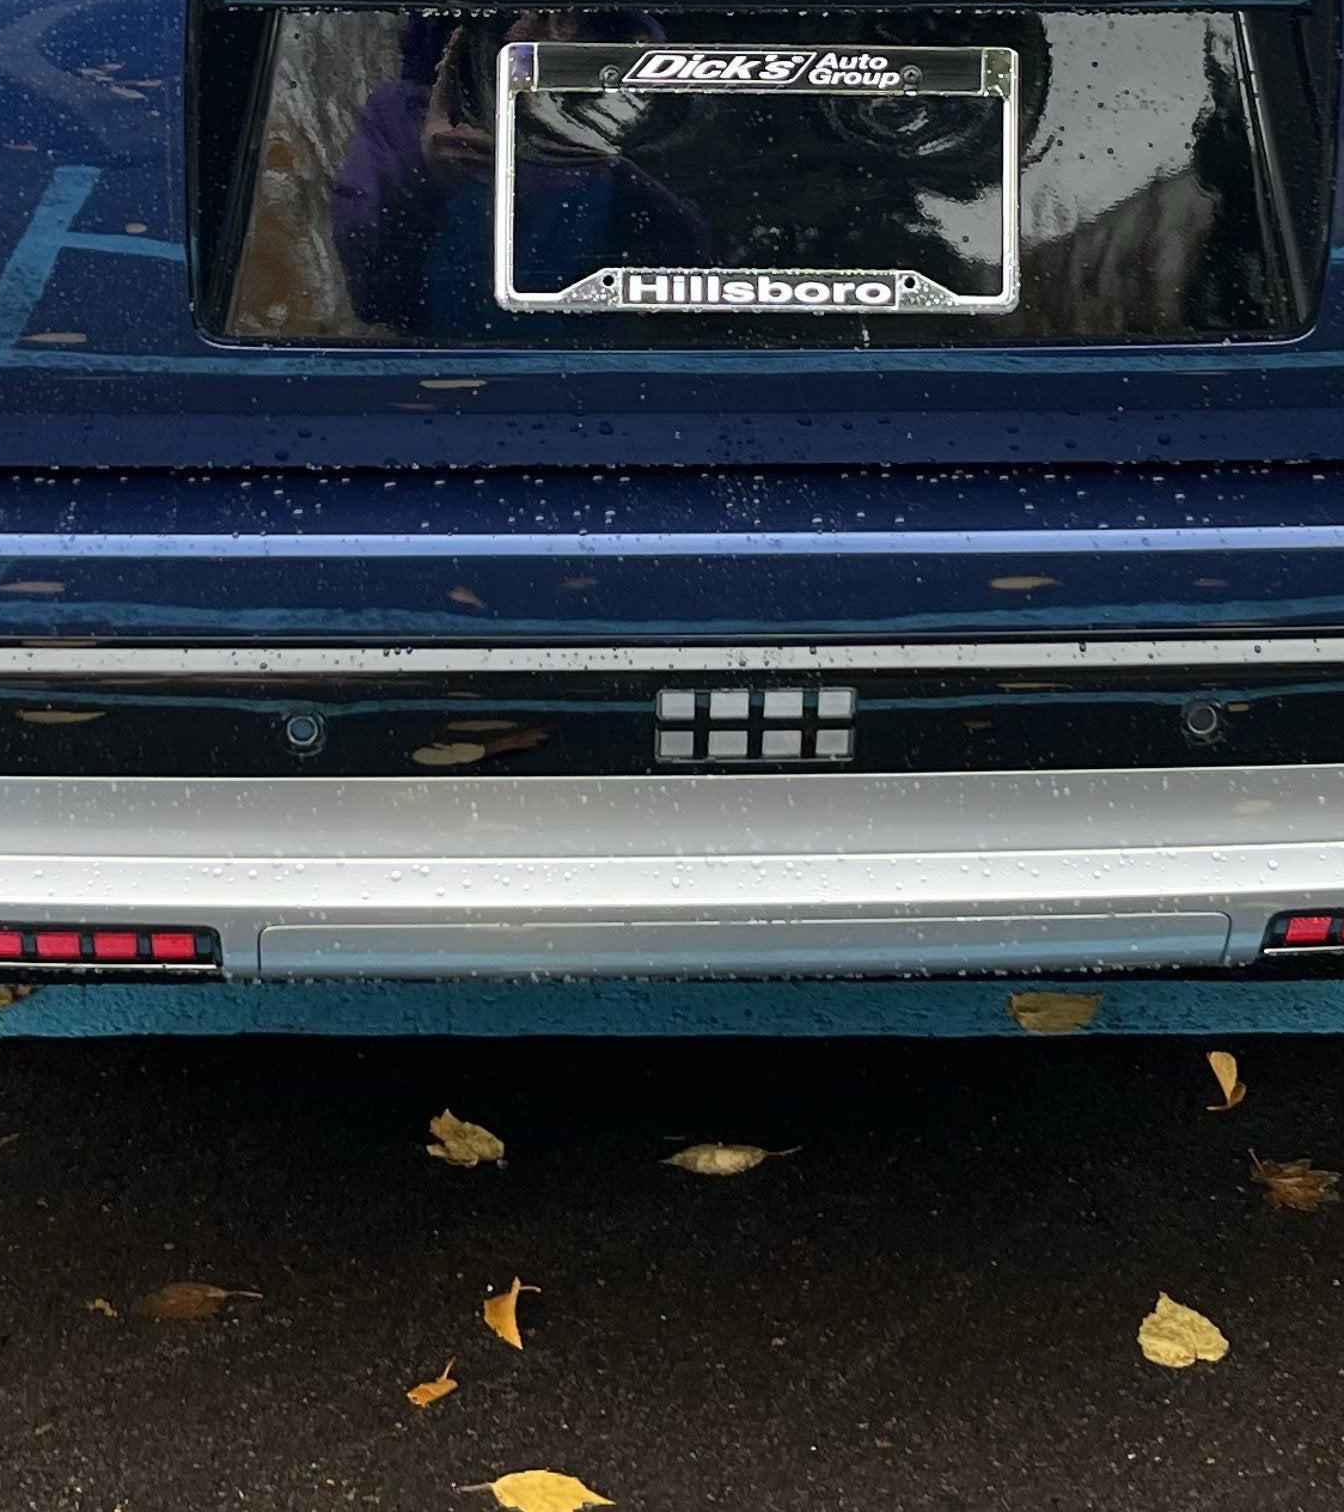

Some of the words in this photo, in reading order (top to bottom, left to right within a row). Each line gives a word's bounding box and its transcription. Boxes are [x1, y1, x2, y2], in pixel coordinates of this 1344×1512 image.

[814, 52, 888, 70] Auto
[808, 68, 900, 88] Group
[628, 275, 892, 304] Hillsboro
